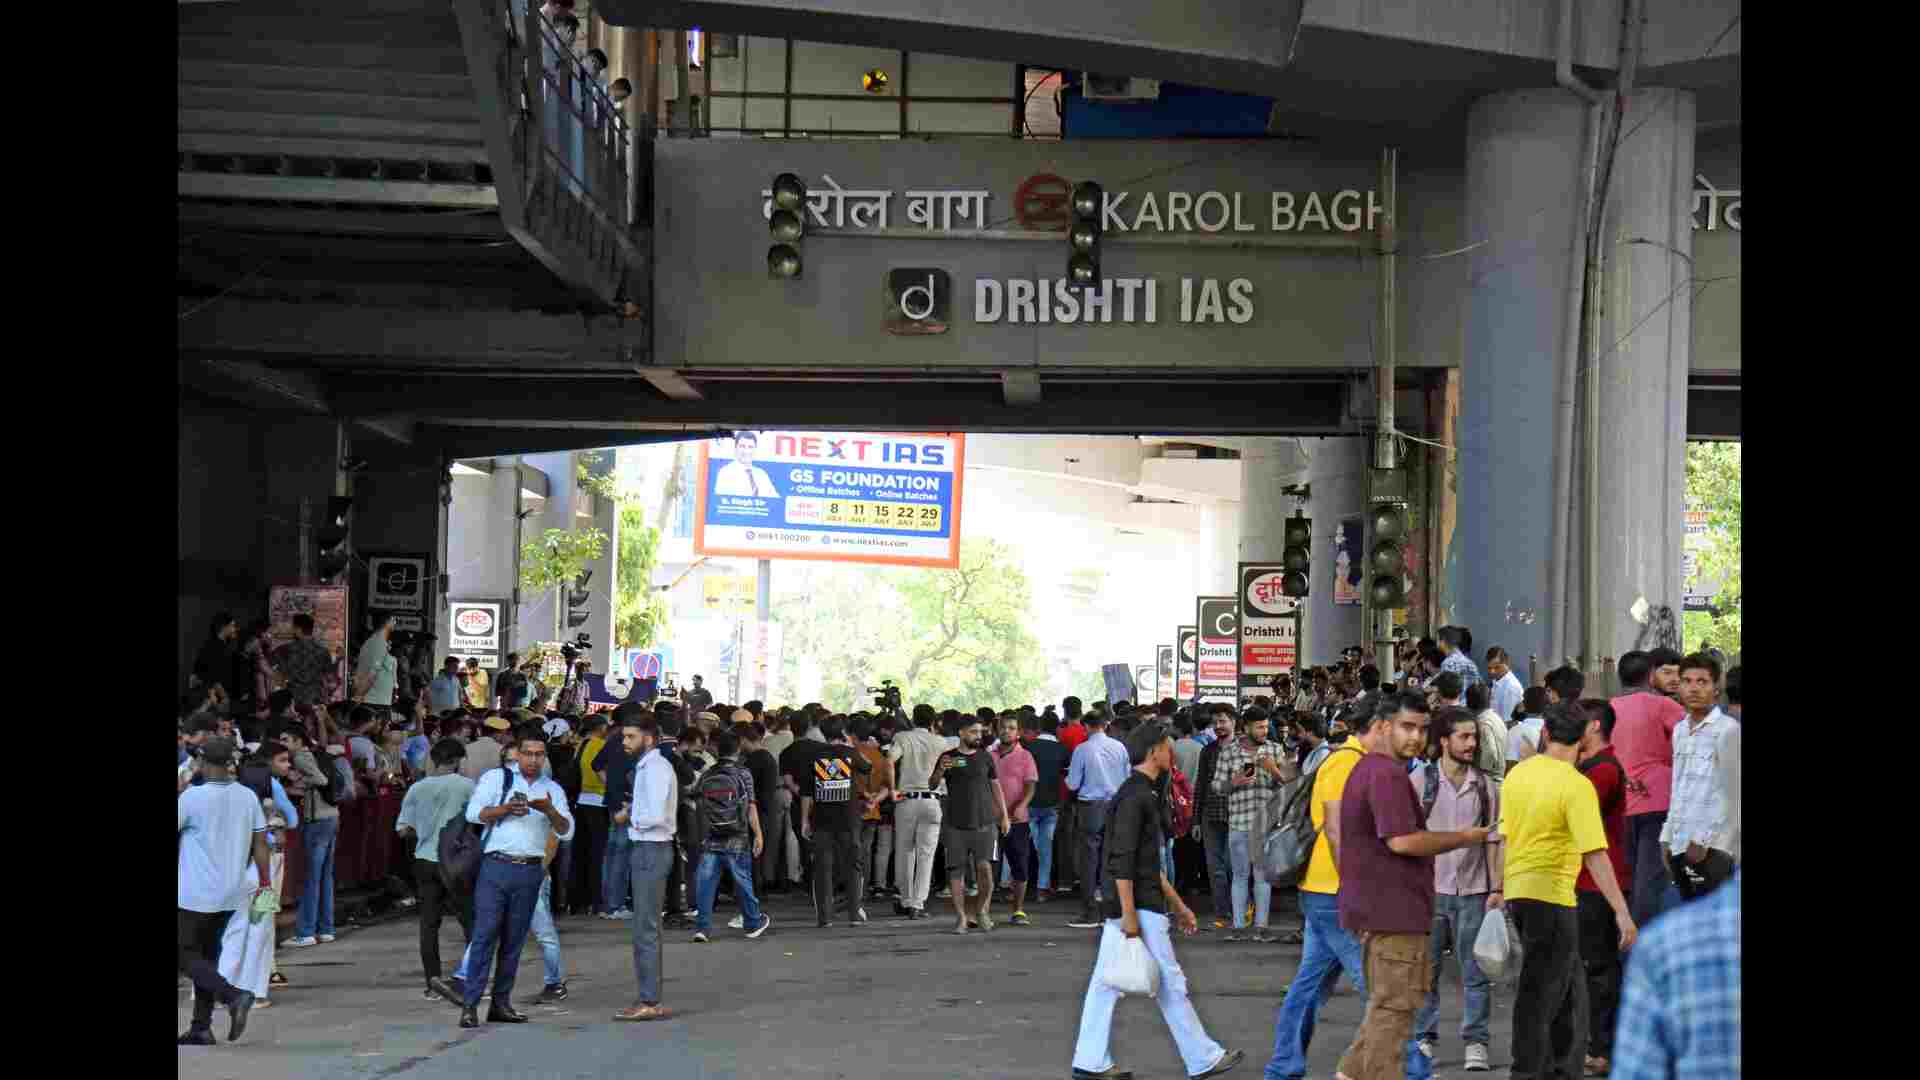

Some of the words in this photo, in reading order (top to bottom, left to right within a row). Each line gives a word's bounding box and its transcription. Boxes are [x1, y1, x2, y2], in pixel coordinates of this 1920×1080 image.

[905, 191, 988, 231] बाग
[1101, 191, 1255, 232] KAROL
[976, 278, 1156, 323] DRISHTI
[1181, 278, 1254, 323] IAS
[883, 442, 945, 465] IAS
[790, 469, 814, 484] GS
[822, 471, 939, 490] FOUNDATION
[830, 503, 839, 513] 8
[853, 504, 864, 515] 11
[875, 506, 889, 517] 15
[897, 507, 914, 518] 22
[921, 508, 938, 519] 29
[1244, 626, 1284, 637] Drishti
[1200, 647, 1232, 657] Drishti
